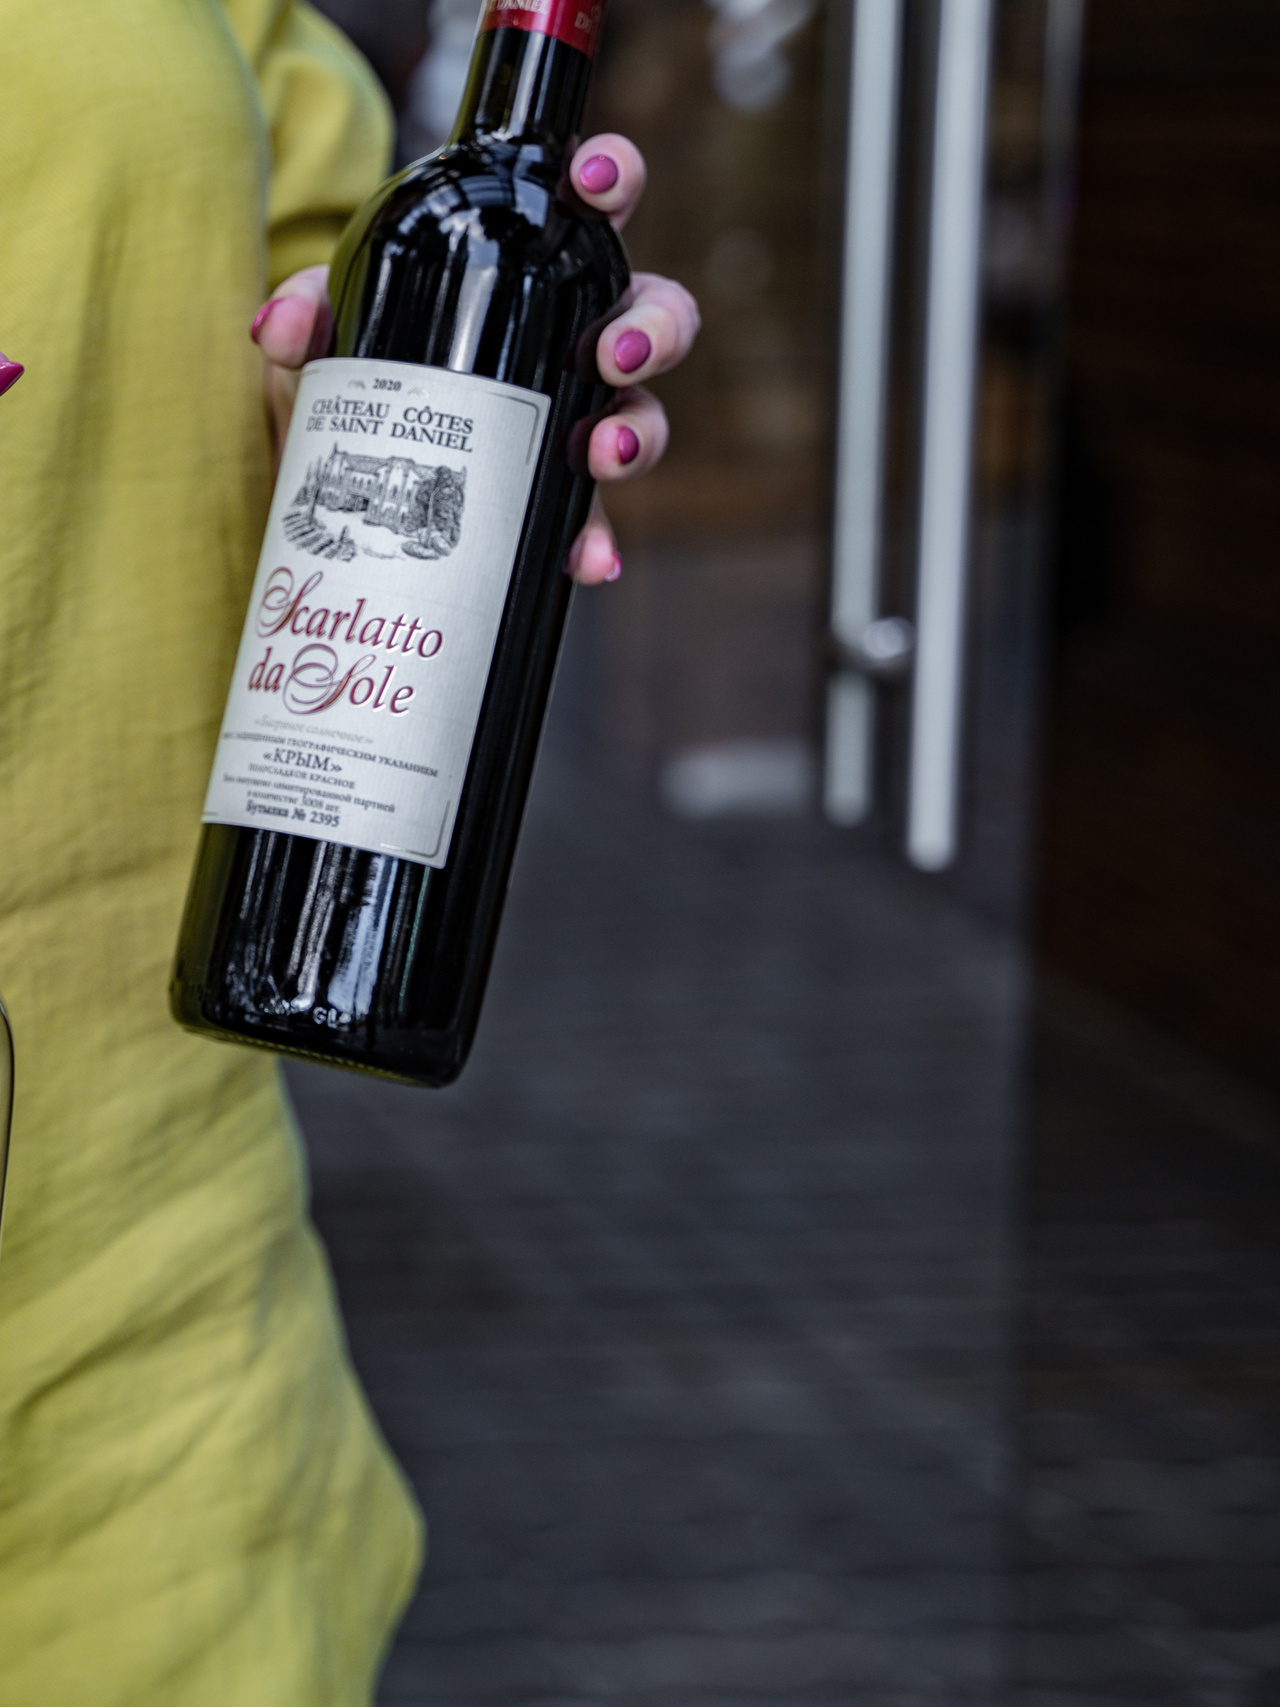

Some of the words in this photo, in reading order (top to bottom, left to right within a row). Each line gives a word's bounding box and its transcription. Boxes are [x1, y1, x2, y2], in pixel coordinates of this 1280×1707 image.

[372, 377, 402, 391] 2020
[312, 395, 390, 419] CHÂTEAU
[403, 405, 474, 434] CÔTES
[306, 416, 322, 432] DE
[329, 416, 383, 436] SAINT
[390, 423, 473, 453] DANIEL
[255, 566, 444, 659] Scarlatto
[248, 646, 286, 692] da
[282, 643, 416, 716] Sole
[263, 747, 343, 773] «КРЫМ»
[378, 755, 439, 778] УКАЗАНИЕМ
[309, 773, 355, 790] КРАСНОЕ
[353, 796, 396, 813] партией
[309, 811, 340, 828] 2395
